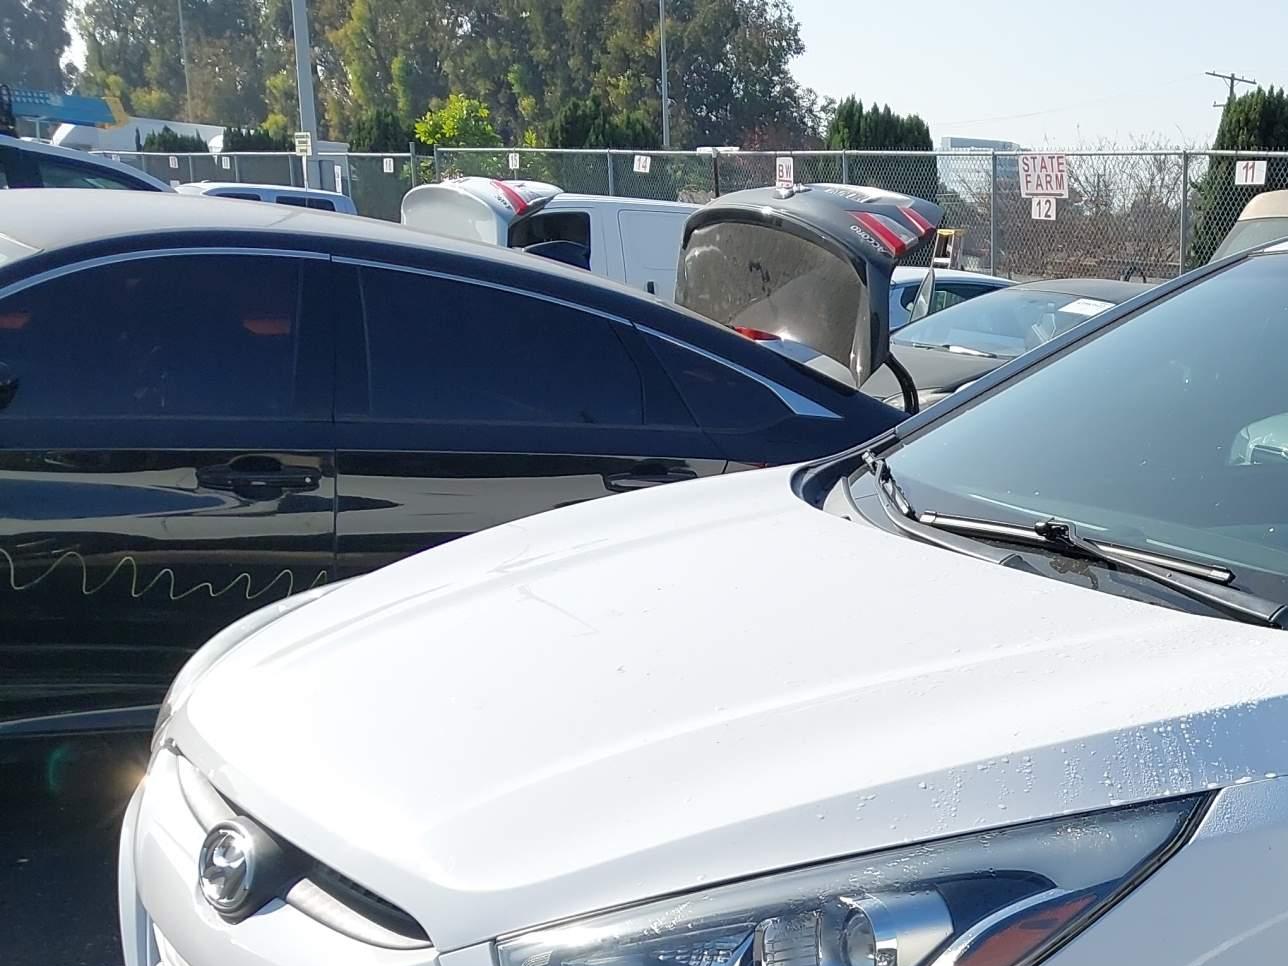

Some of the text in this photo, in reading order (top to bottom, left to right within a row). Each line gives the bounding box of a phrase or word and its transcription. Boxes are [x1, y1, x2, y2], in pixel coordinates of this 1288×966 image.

[636, 157, 648, 171] 14
[1022, 156, 1066, 173] STATE
[1242, 162, 1256, 182] 11
[1025, 173, 1066, 191] FARM
[1035, 199, 1052, 219] 12
